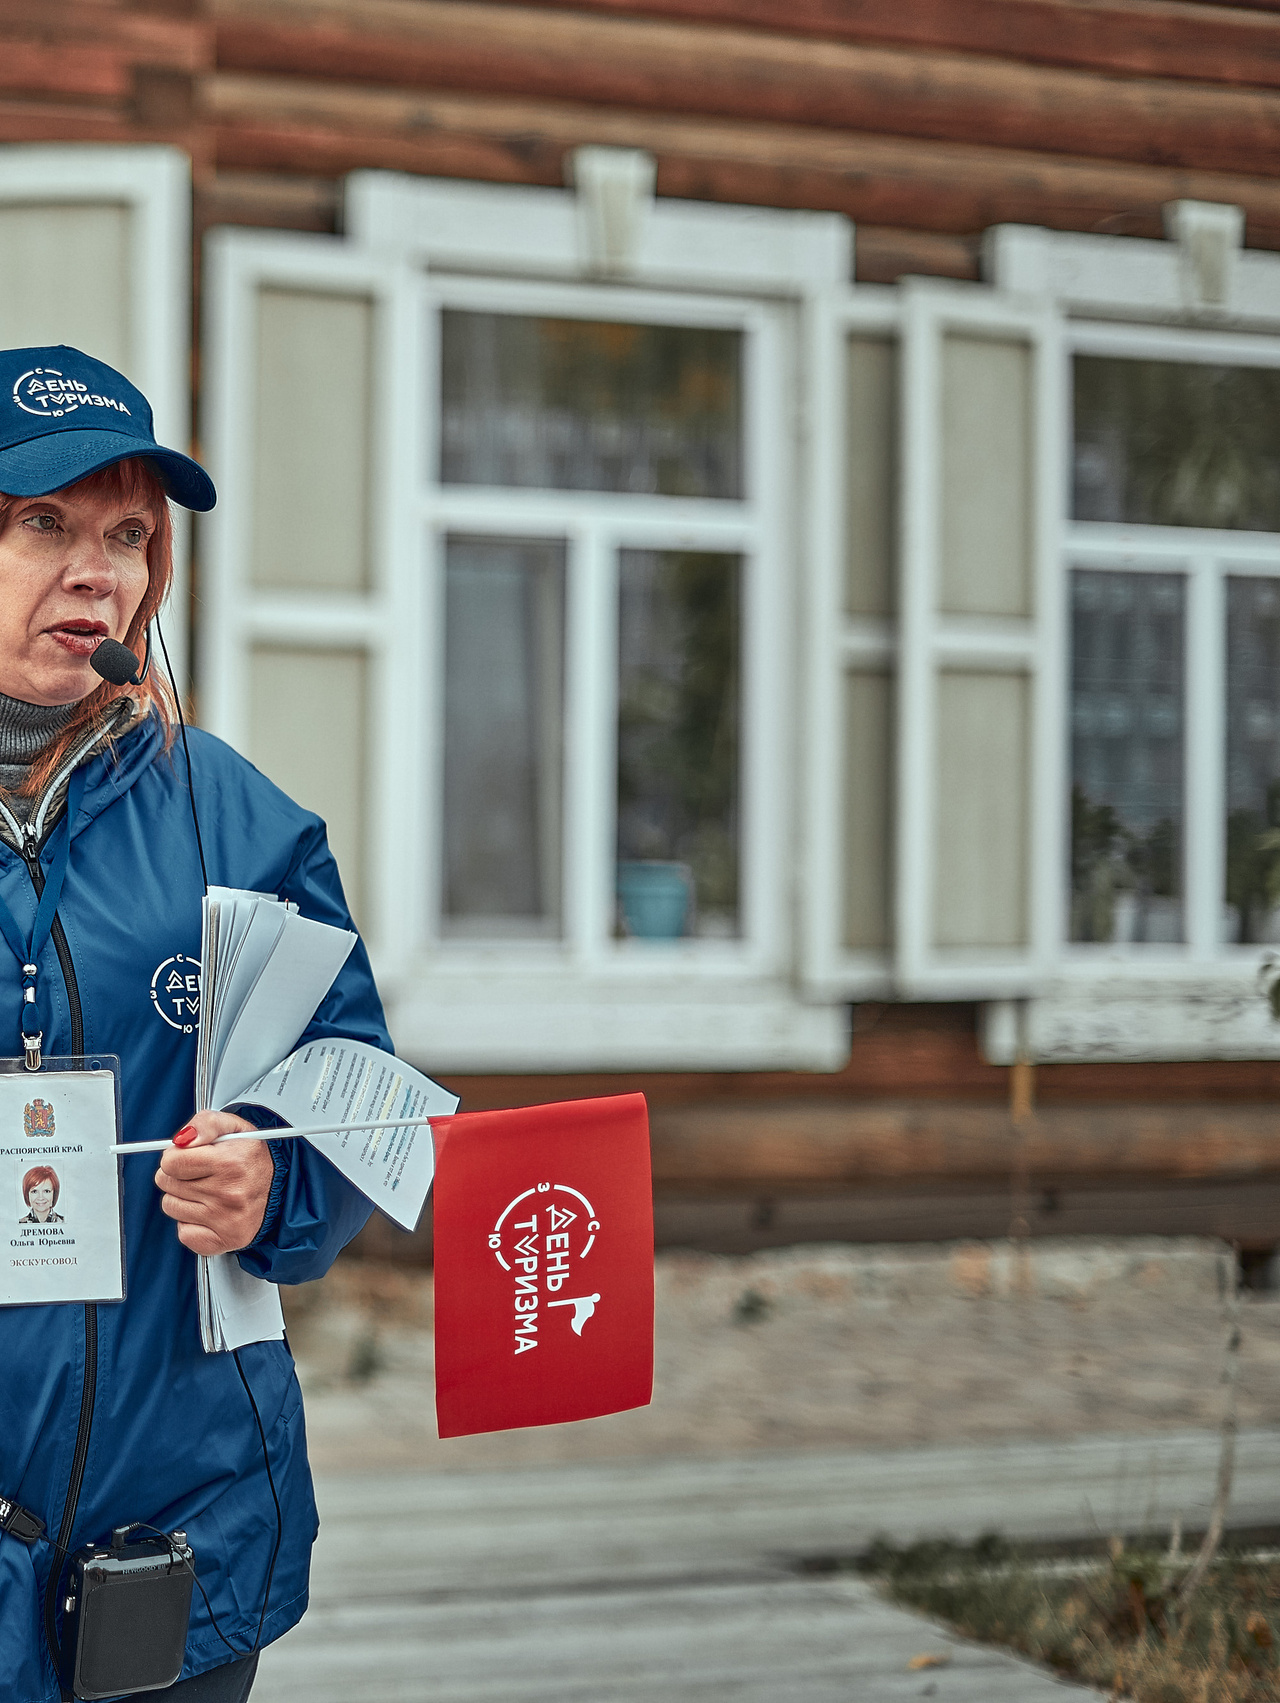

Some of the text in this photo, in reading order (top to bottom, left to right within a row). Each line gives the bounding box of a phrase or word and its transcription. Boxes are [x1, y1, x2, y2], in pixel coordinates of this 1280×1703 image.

[26, 378, 88, 396] ДЕНЬ
[35, 392, 132, 416] ТУРИЗМА
[165, 969, 201, 993] ДЕ
[61, 1144, 83, 1153] КРАЙ
[20, 1228, 64, 1237] ДРЕМОВА
[10, 1238, 76, 1247] Ольга Юрьевна
[545, 1203, 578, 1292] ДЕНЬ
[9, 1257, 78, 1267] ЭКСКУРСОВОД
[513, 1214, 540, 1355] ТУРИЗМА
